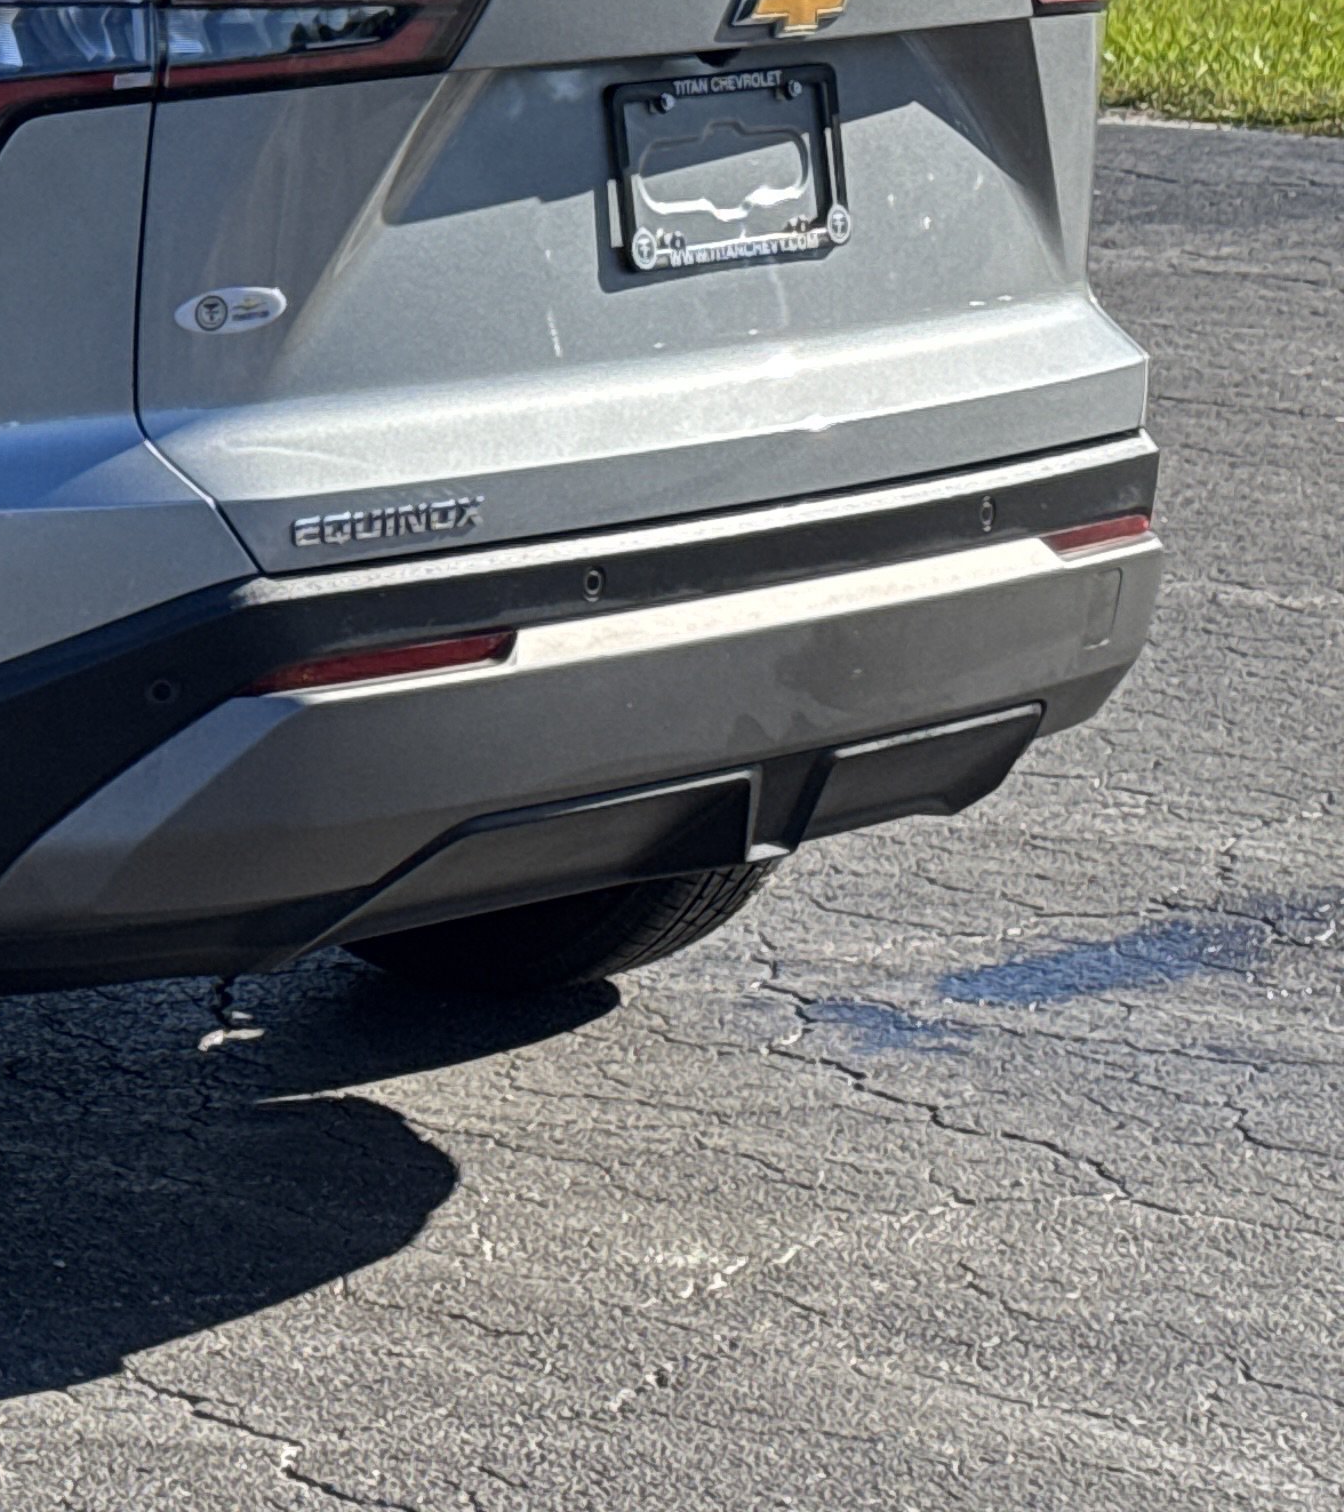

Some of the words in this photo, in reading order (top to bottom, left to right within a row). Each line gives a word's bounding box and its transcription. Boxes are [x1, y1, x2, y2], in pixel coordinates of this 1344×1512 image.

[673, 76, 708, 95] TITAN
[711, 70, 782, 92] CHEVROLET
[292, 495, 485, 547] EQUINOX
